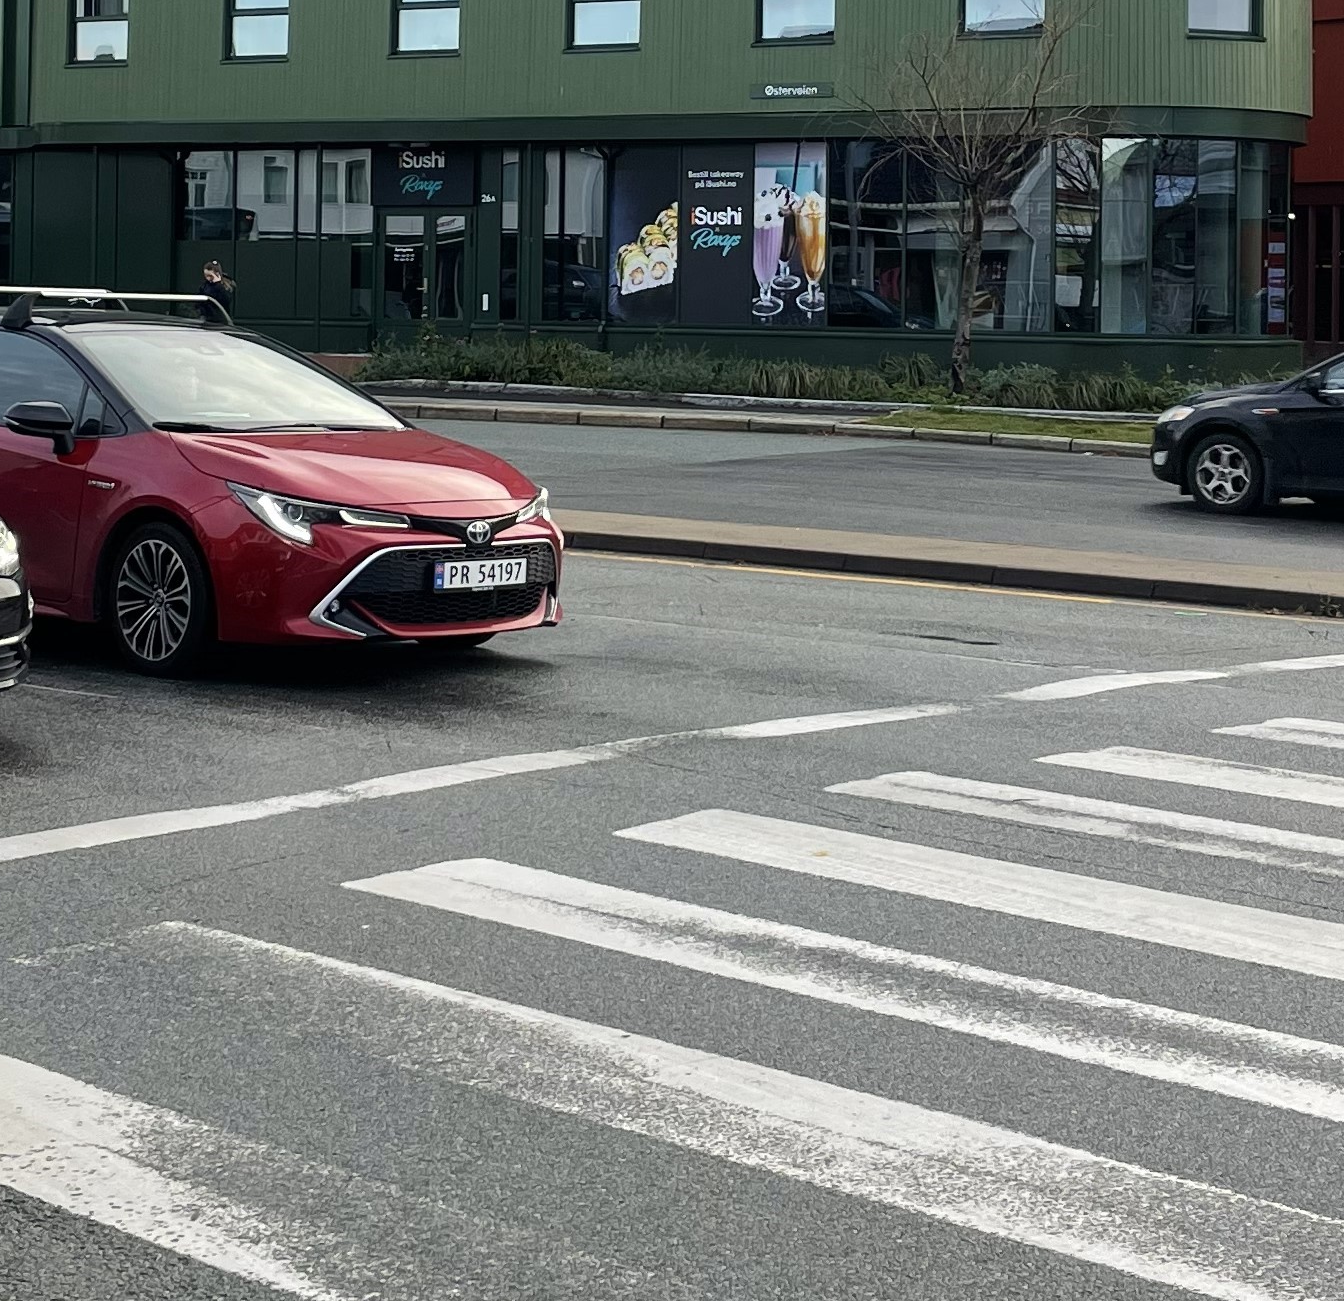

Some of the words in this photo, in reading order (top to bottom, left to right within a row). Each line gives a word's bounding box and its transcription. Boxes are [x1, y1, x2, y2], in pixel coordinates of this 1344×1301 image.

[764, 84, 818, 96] Østerveien
[398, 151, 445, 169] iSushi
[690, 206, 743, 226] iSushi
[449, 564, 470, 585] PR
[478, 561, 523, 584] 54197
